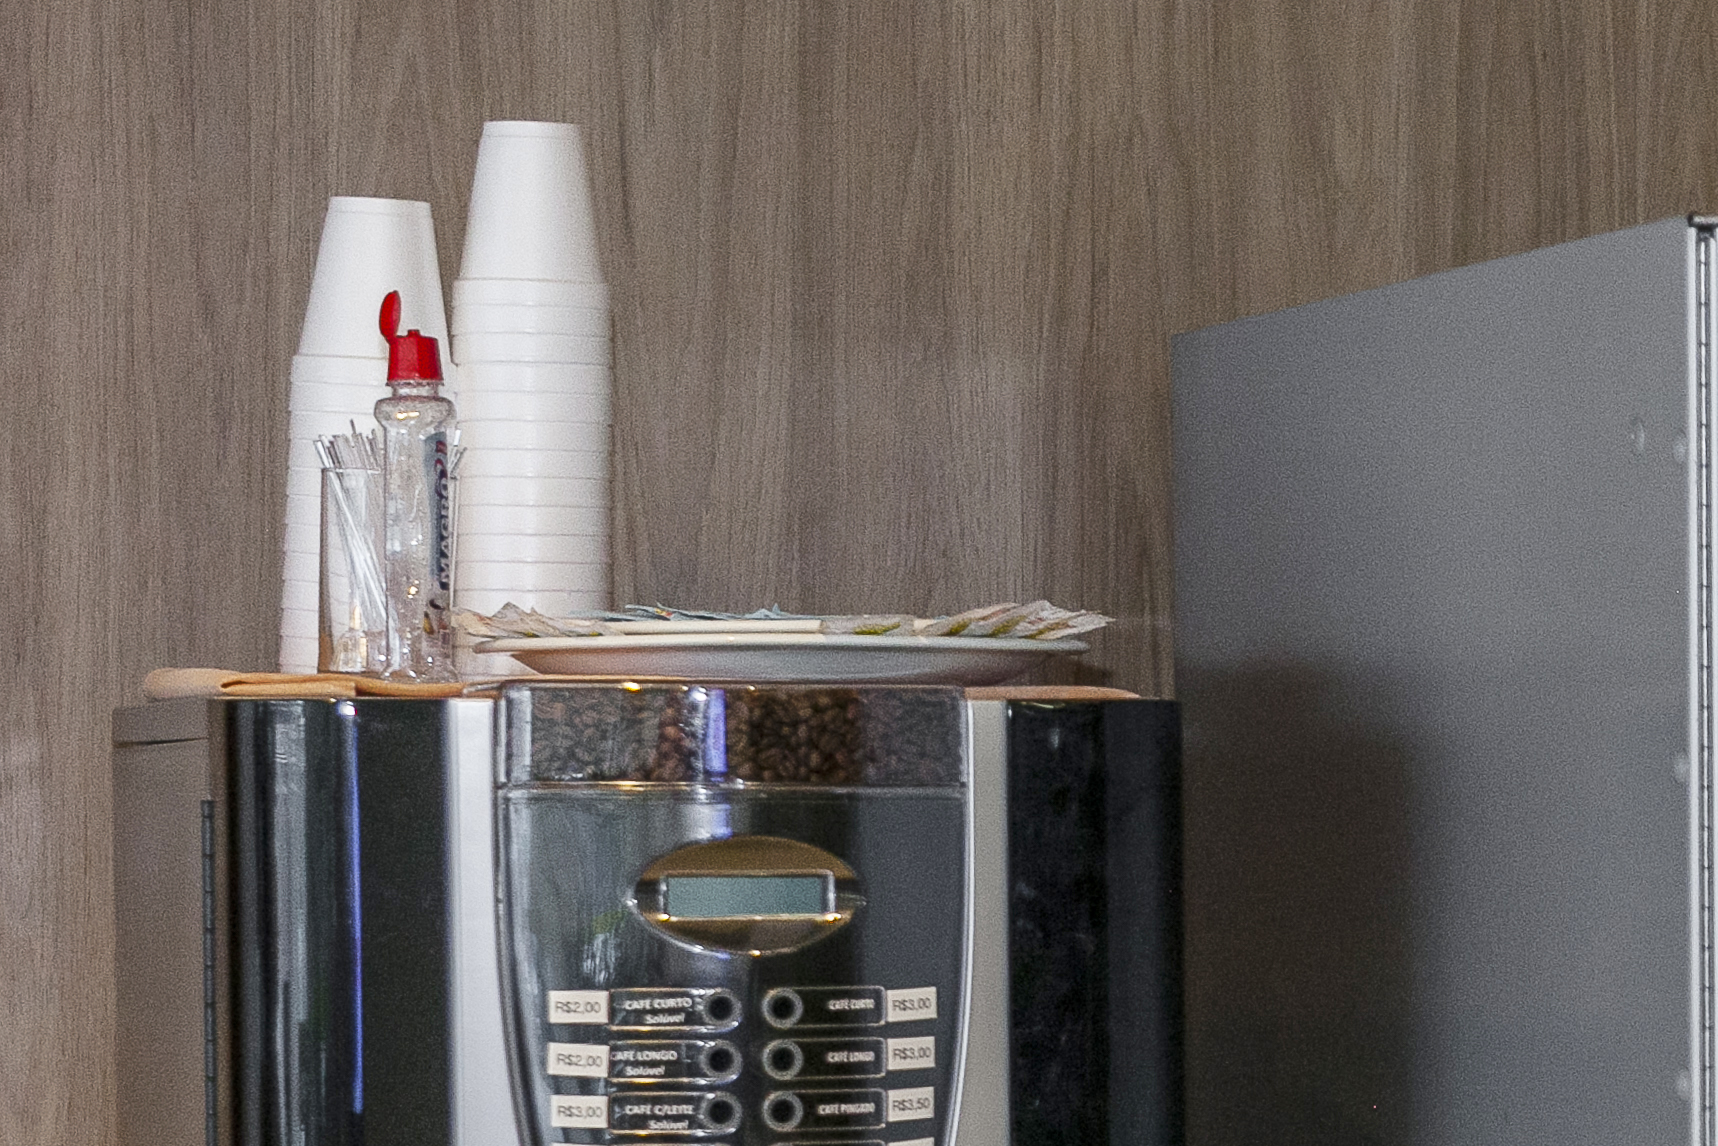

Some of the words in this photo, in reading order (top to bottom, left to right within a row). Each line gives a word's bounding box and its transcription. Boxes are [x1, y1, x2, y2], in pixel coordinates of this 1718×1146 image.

[555, 1001, 602, 1014] R$2,00
[892, 997, 932, 1012] R$3,00
[557, 1053, 603, 1067] R$2,00
[893, 1046, 932, 1061] R$3,00
[892, 1096, 931, 1112] R$3,50
[557, 1105, 604, 1119] R$3,00
